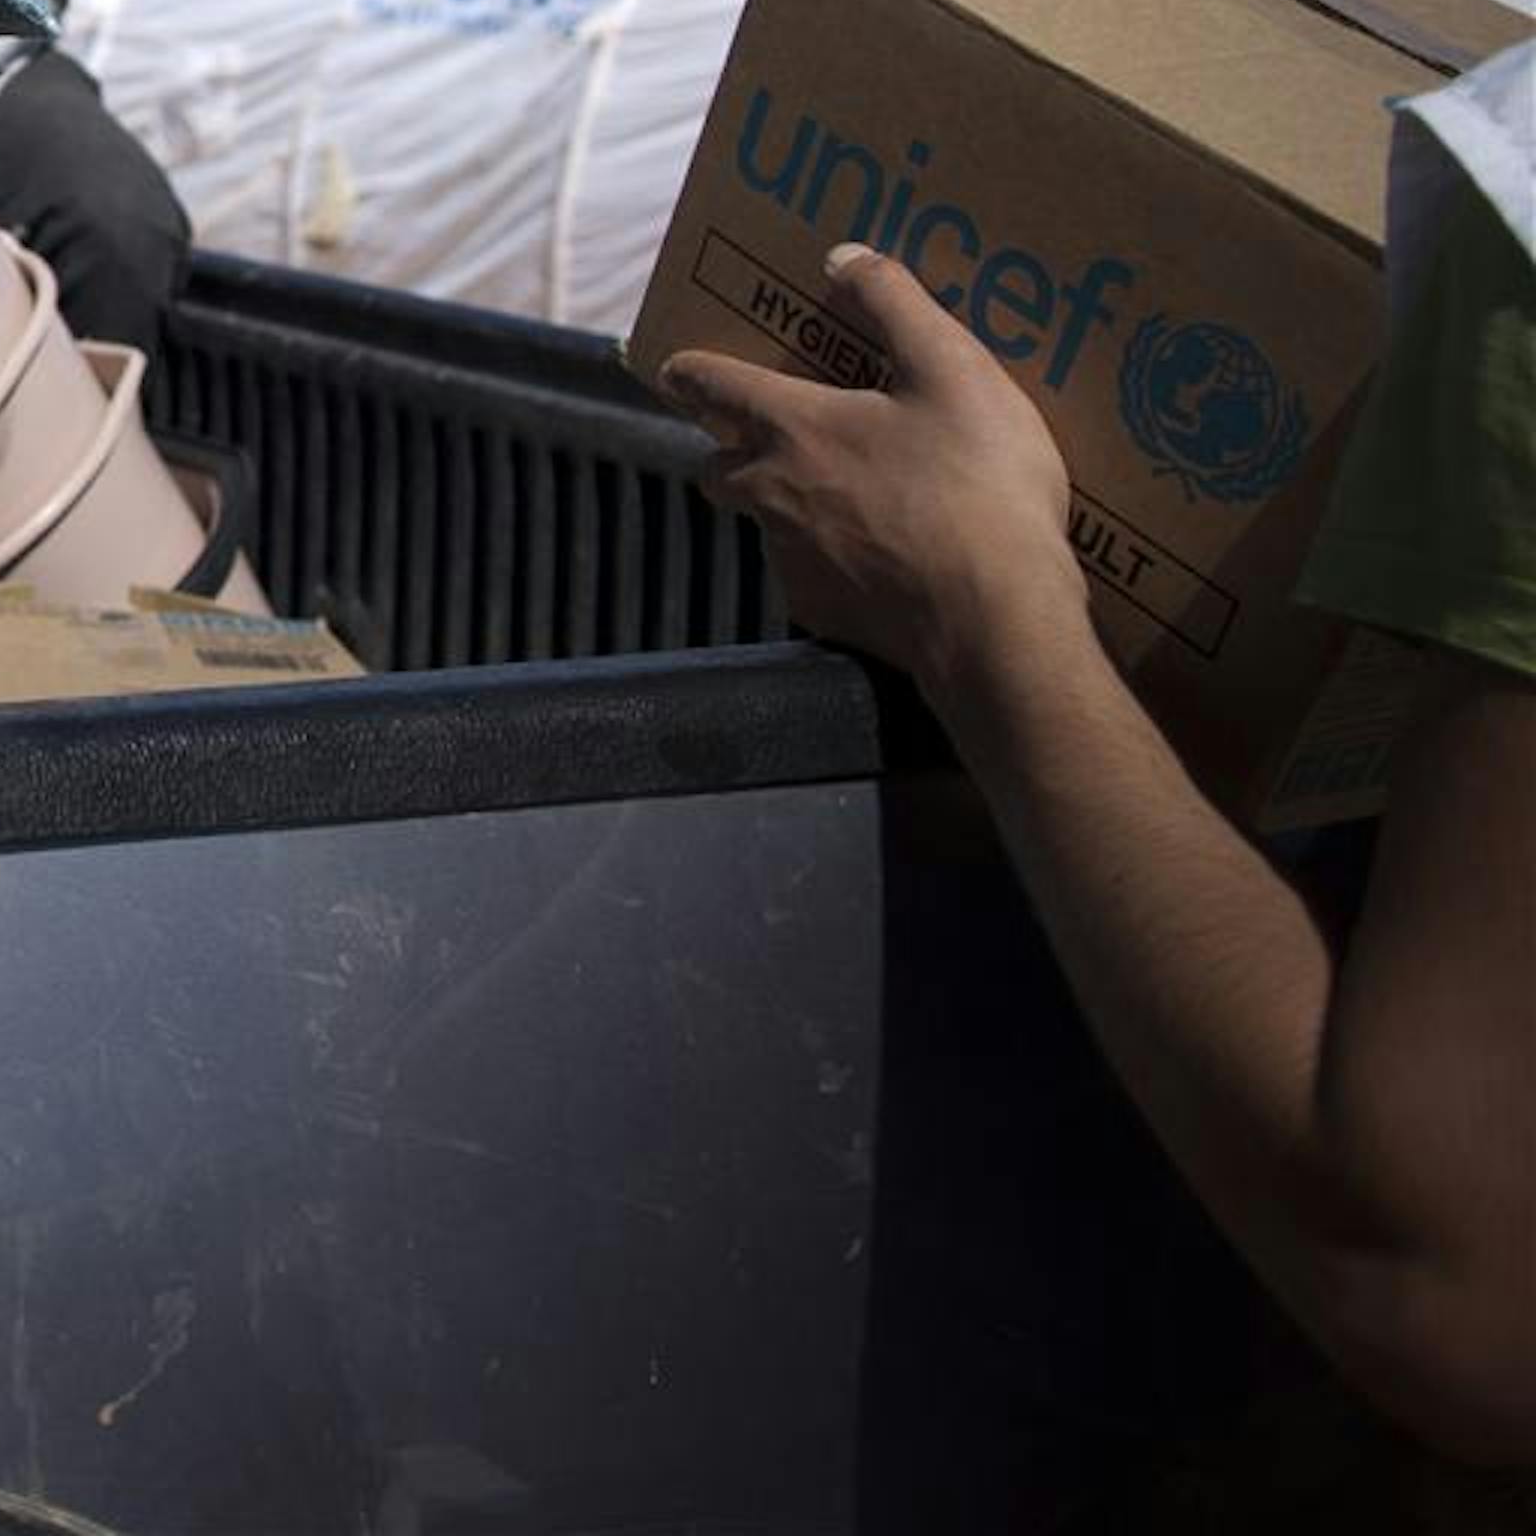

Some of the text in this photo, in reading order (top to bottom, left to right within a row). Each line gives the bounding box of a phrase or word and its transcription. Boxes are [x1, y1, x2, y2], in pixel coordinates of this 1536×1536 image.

[736, 87, 1138, 388] unicef
[749, 280, 1155, 587] HYGIEN ULT
